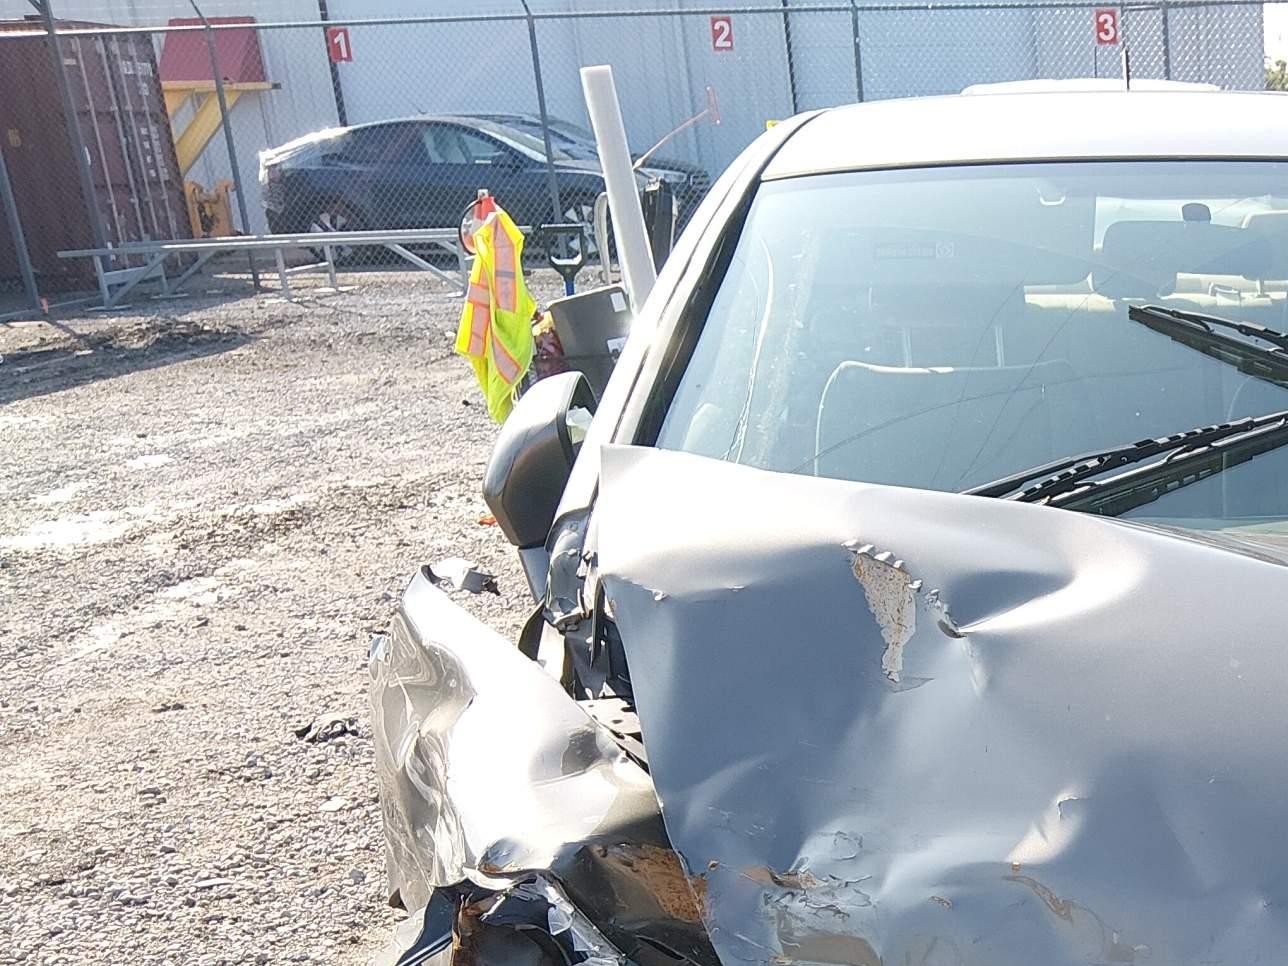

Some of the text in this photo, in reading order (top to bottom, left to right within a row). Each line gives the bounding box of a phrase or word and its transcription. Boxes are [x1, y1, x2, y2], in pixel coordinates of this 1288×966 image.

[713, 20, 732, 48] 2
[1097, 13, 1116, 41] 3
[333, 31, 348, 59] 1
